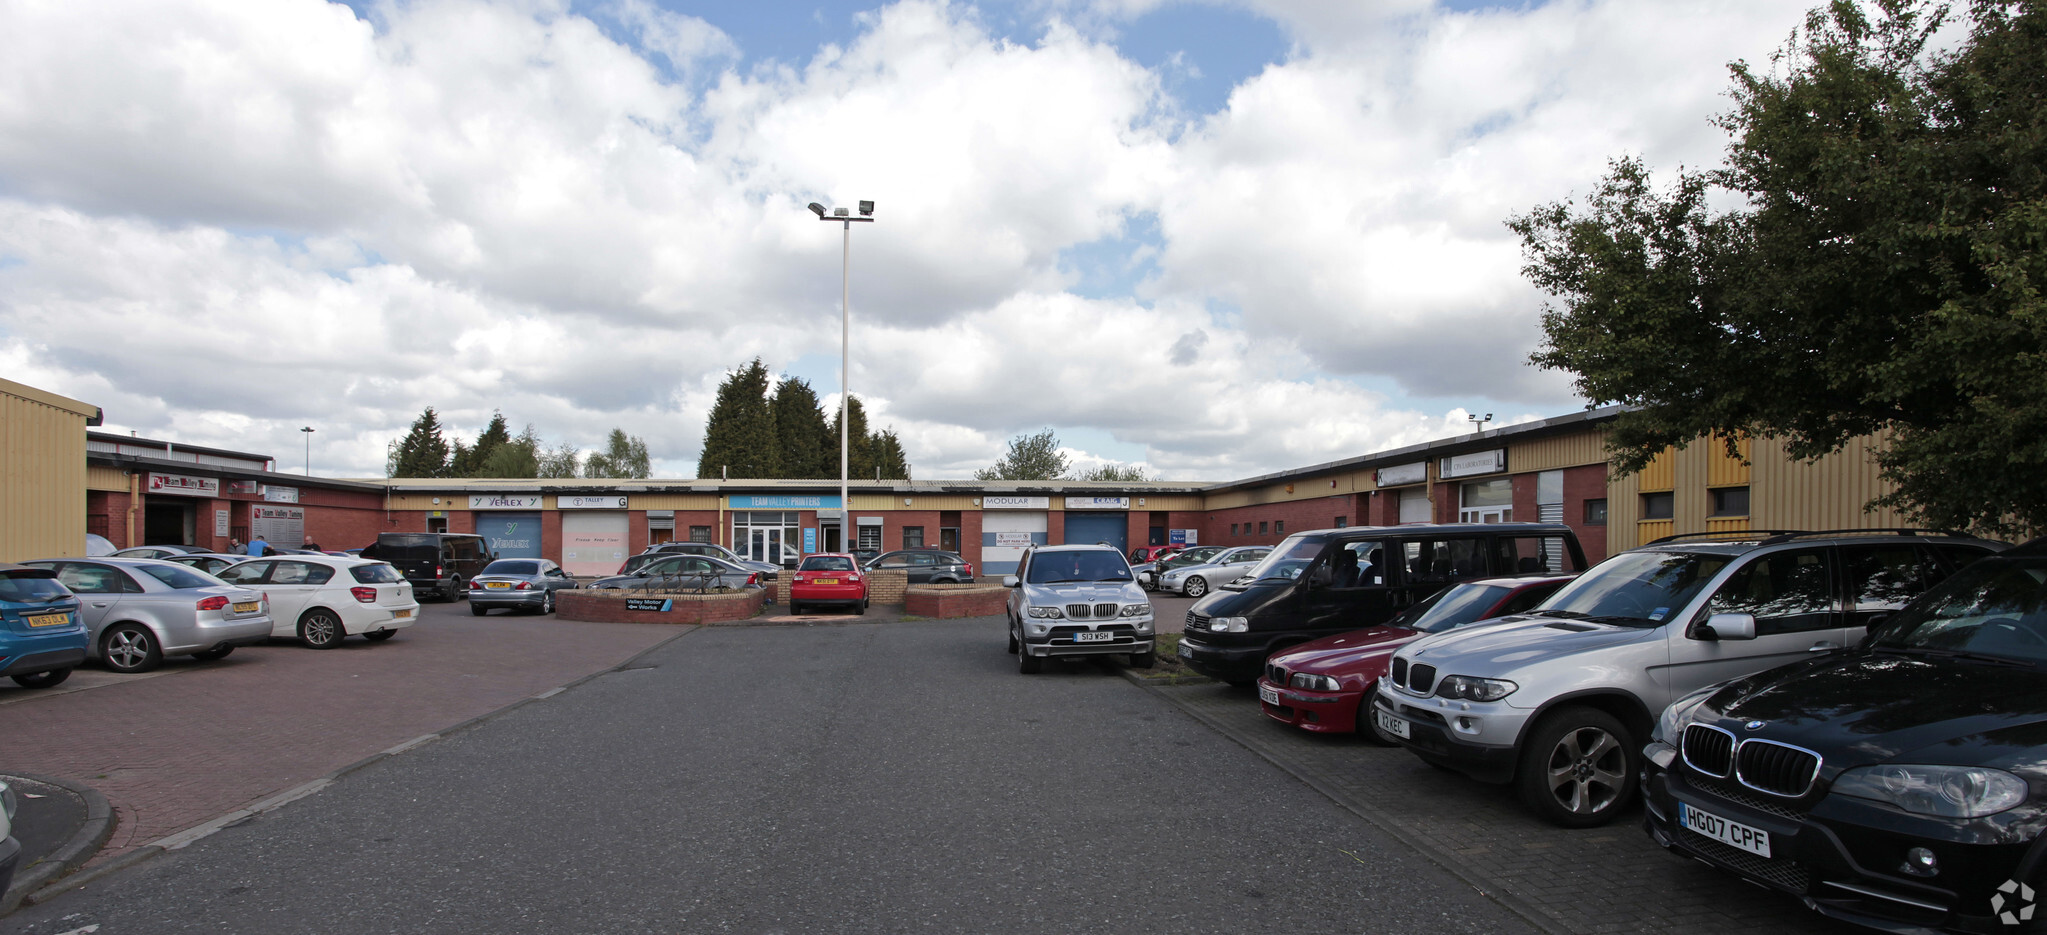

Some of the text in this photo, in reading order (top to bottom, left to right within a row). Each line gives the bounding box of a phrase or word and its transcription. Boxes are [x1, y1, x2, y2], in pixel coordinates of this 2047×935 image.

[1462, 459, 1493, 469] LABORATORIES
[1497, 453, 1503, 467] L
[1378, 471, 1383, 483] K
[164, 476, 180, 485] Team
[180, 478, 197, 489] Valley
[198, 480, 217, 490] Tuning
[489, 498, 522, 506] YEHLEX
[619, 498, 626, 506] G
[751, 497, 821, 506] TEAM VALLEY PRINTERS
[262, 508, 303, 519] Team Valley Tuning
[491, 538, 530, 549] YEHLEX
[1390, 718, 1402, 733] KEC
[1687, 807, 1765, 850] HG07 CPF
